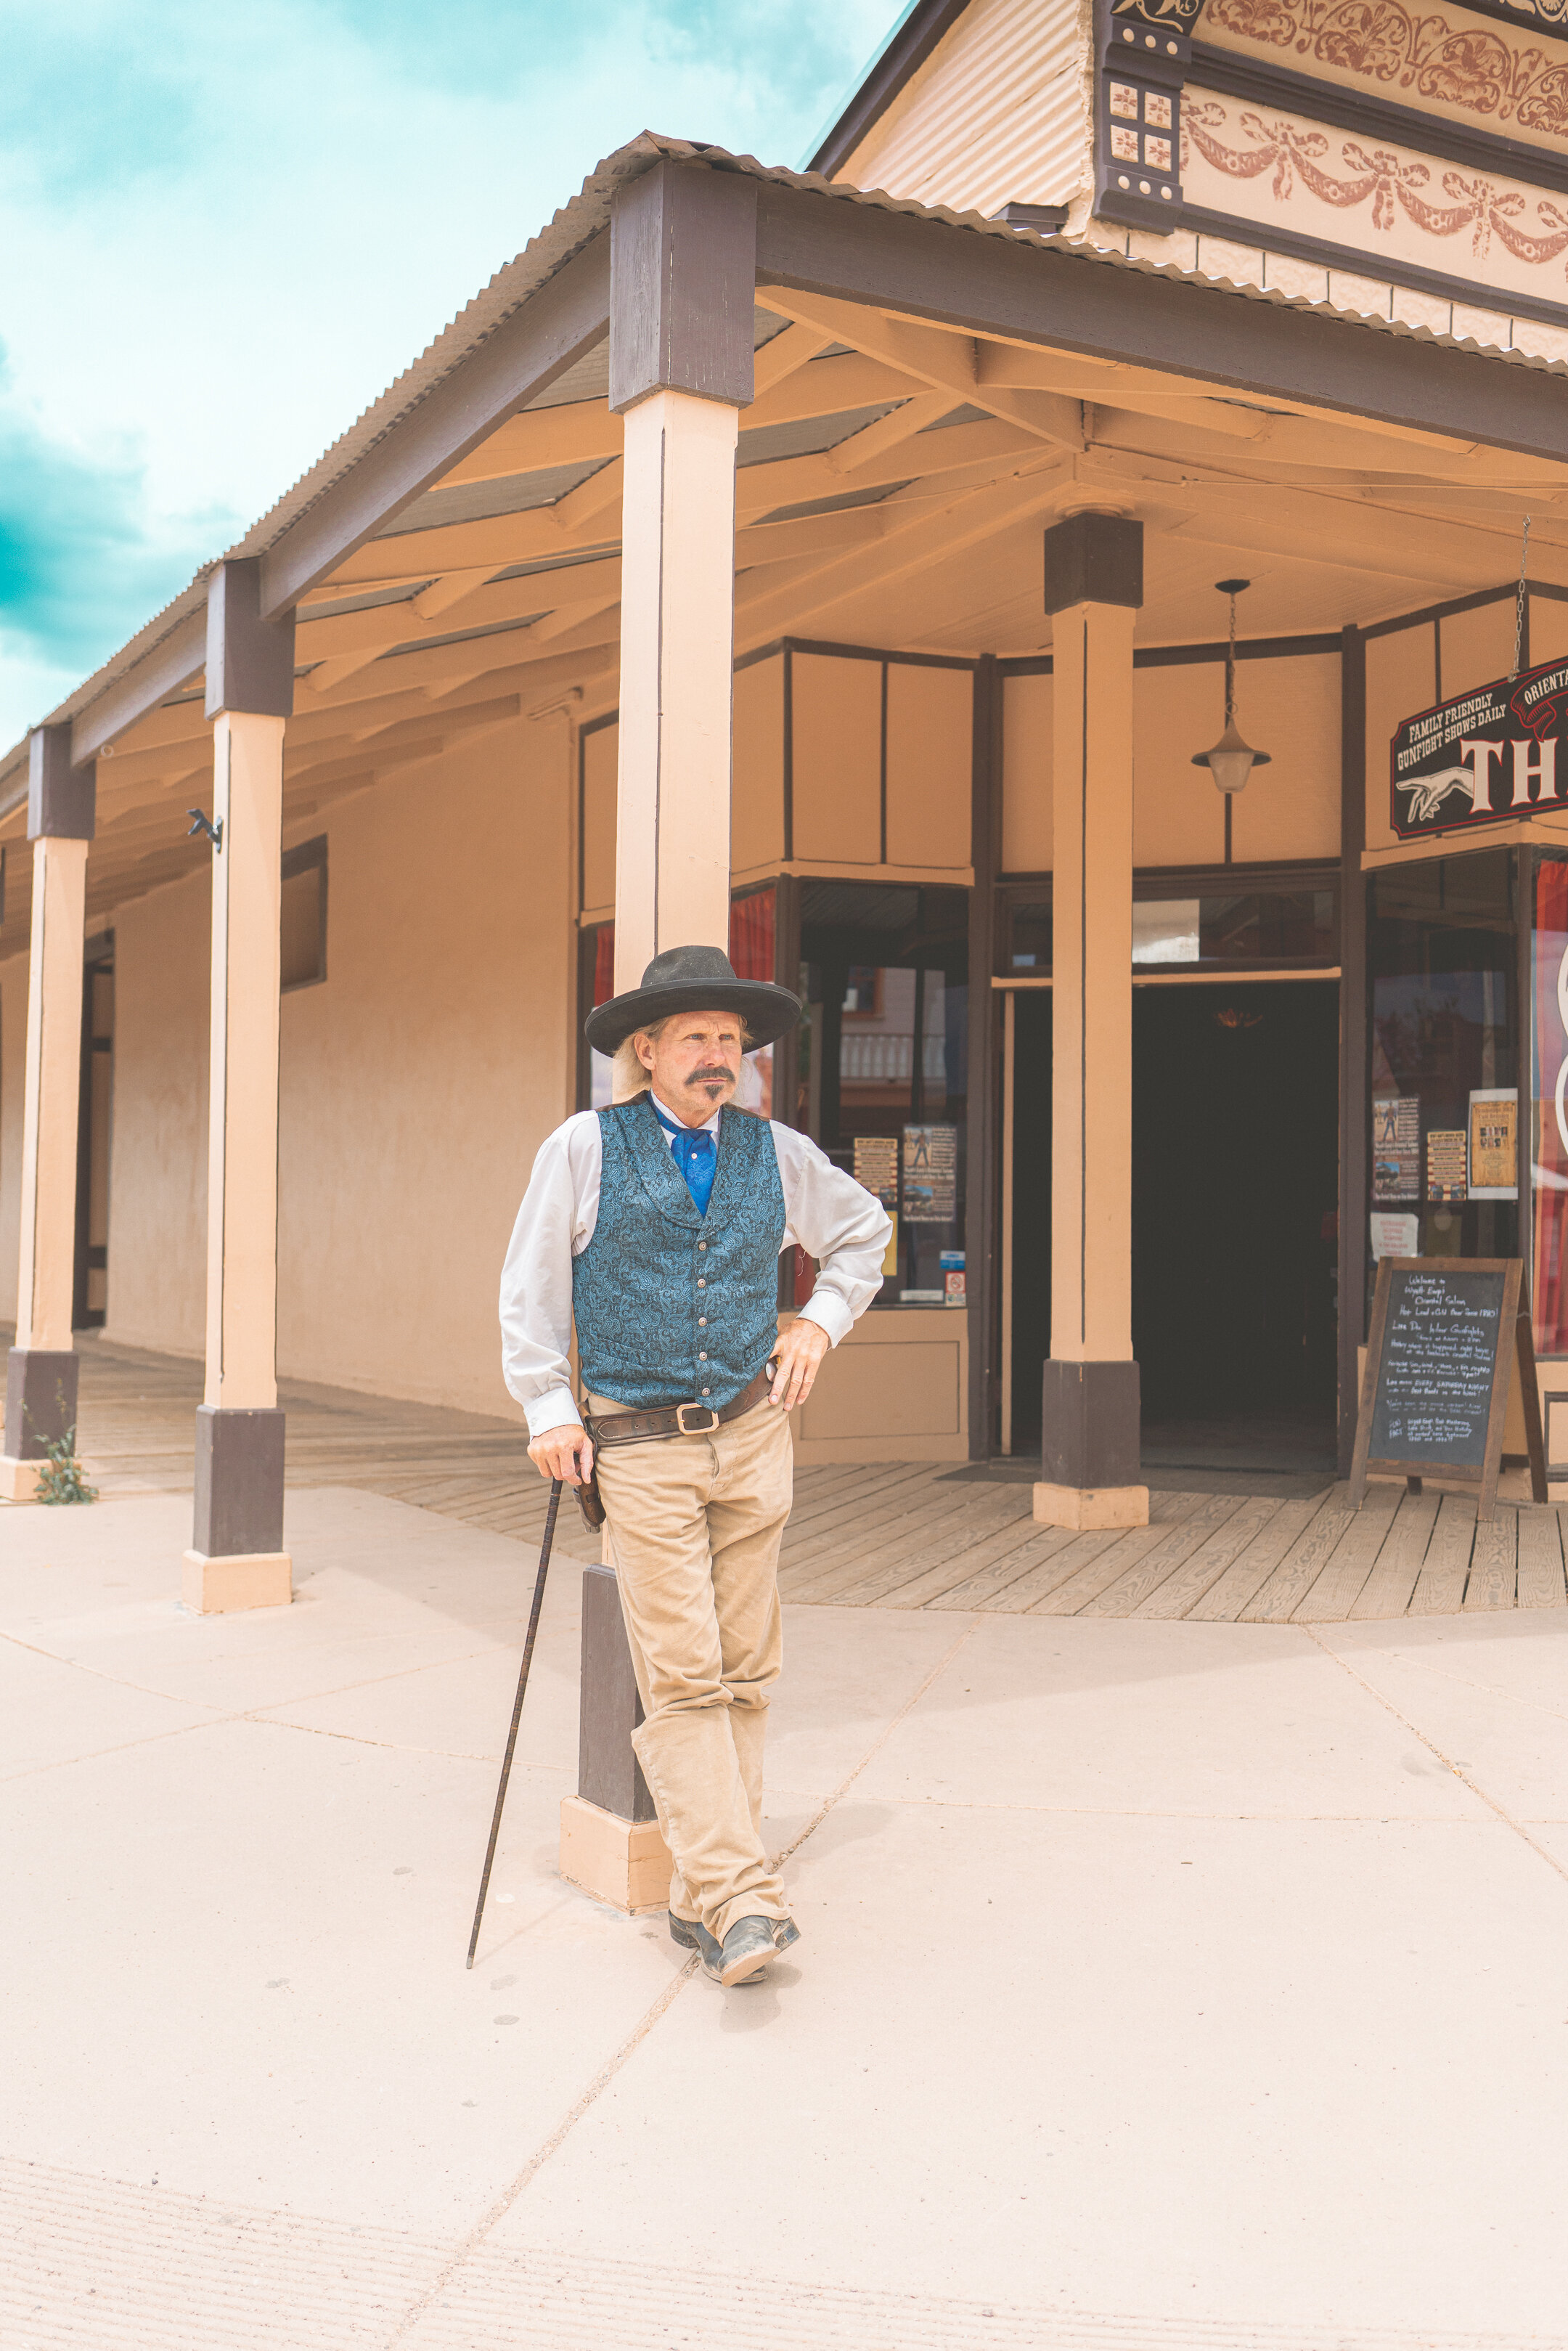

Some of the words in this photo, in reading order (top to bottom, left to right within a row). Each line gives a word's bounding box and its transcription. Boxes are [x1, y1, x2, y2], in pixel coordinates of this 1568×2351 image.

[1397, 731, 1443, 771] GUNFIGHT
[1445, 715, 1477, 743] SHOWS
[1477, 704, 1506, 726] DAILY
[1409, 712, 1443, 743] FAMILY
[1445, 693, 1493, 725] FRIENDLY
[1460, 736, 1568, 814] TH
[1405, 1286, 1425, 1298] Wyatt
